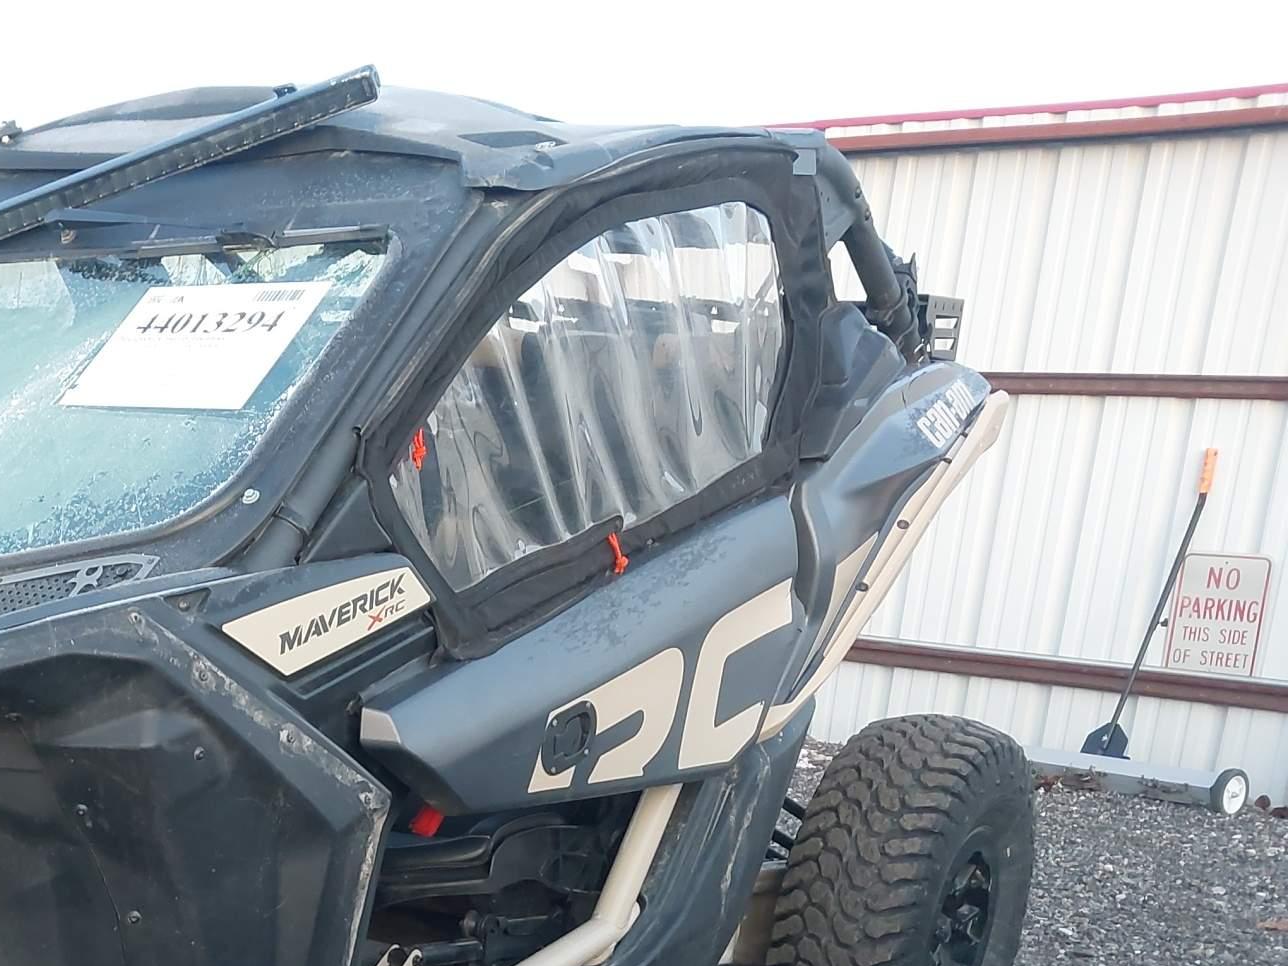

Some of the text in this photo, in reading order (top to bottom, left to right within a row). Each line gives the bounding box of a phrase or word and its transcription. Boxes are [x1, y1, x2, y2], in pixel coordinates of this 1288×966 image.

[136, 310, 286, 334] 44013294
[1206, 566, 1241, 590] NO
[279, 572, 406, 656] MAVERICK
[1178, 595, 1259, 623] PARKING
[1182, 625, 1249, 645] THIS SIDE
[1172, 647, 1249, 669] OF STREET
